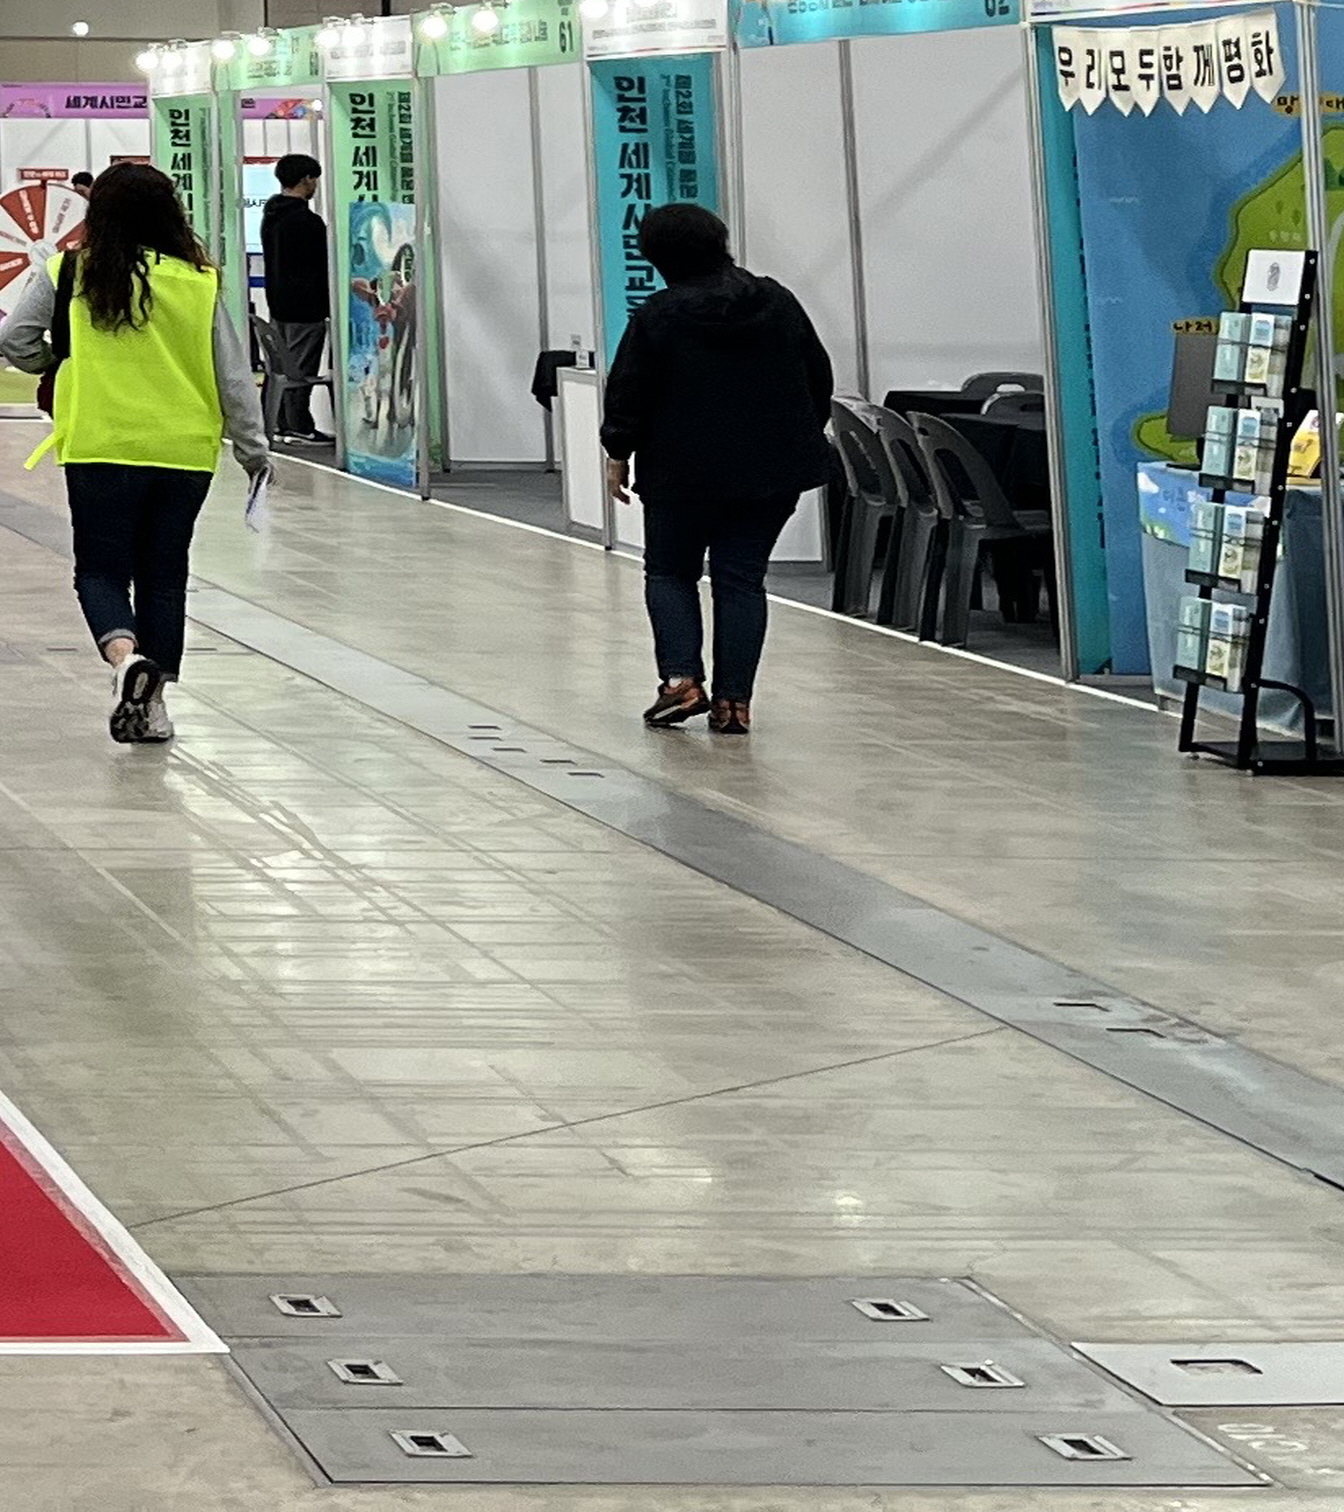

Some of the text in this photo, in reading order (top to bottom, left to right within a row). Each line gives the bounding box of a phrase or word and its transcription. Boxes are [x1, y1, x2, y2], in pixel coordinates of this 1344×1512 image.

[559, 20, 575, 54] 61
[55, 95, 147, 109] 세계시민교
[614, 76, 648, 134] 인천
[675, 74, 694, 115] 제2회
[169, 108, 191, 148] 인천
[349, 92, 377, 139] 인천
